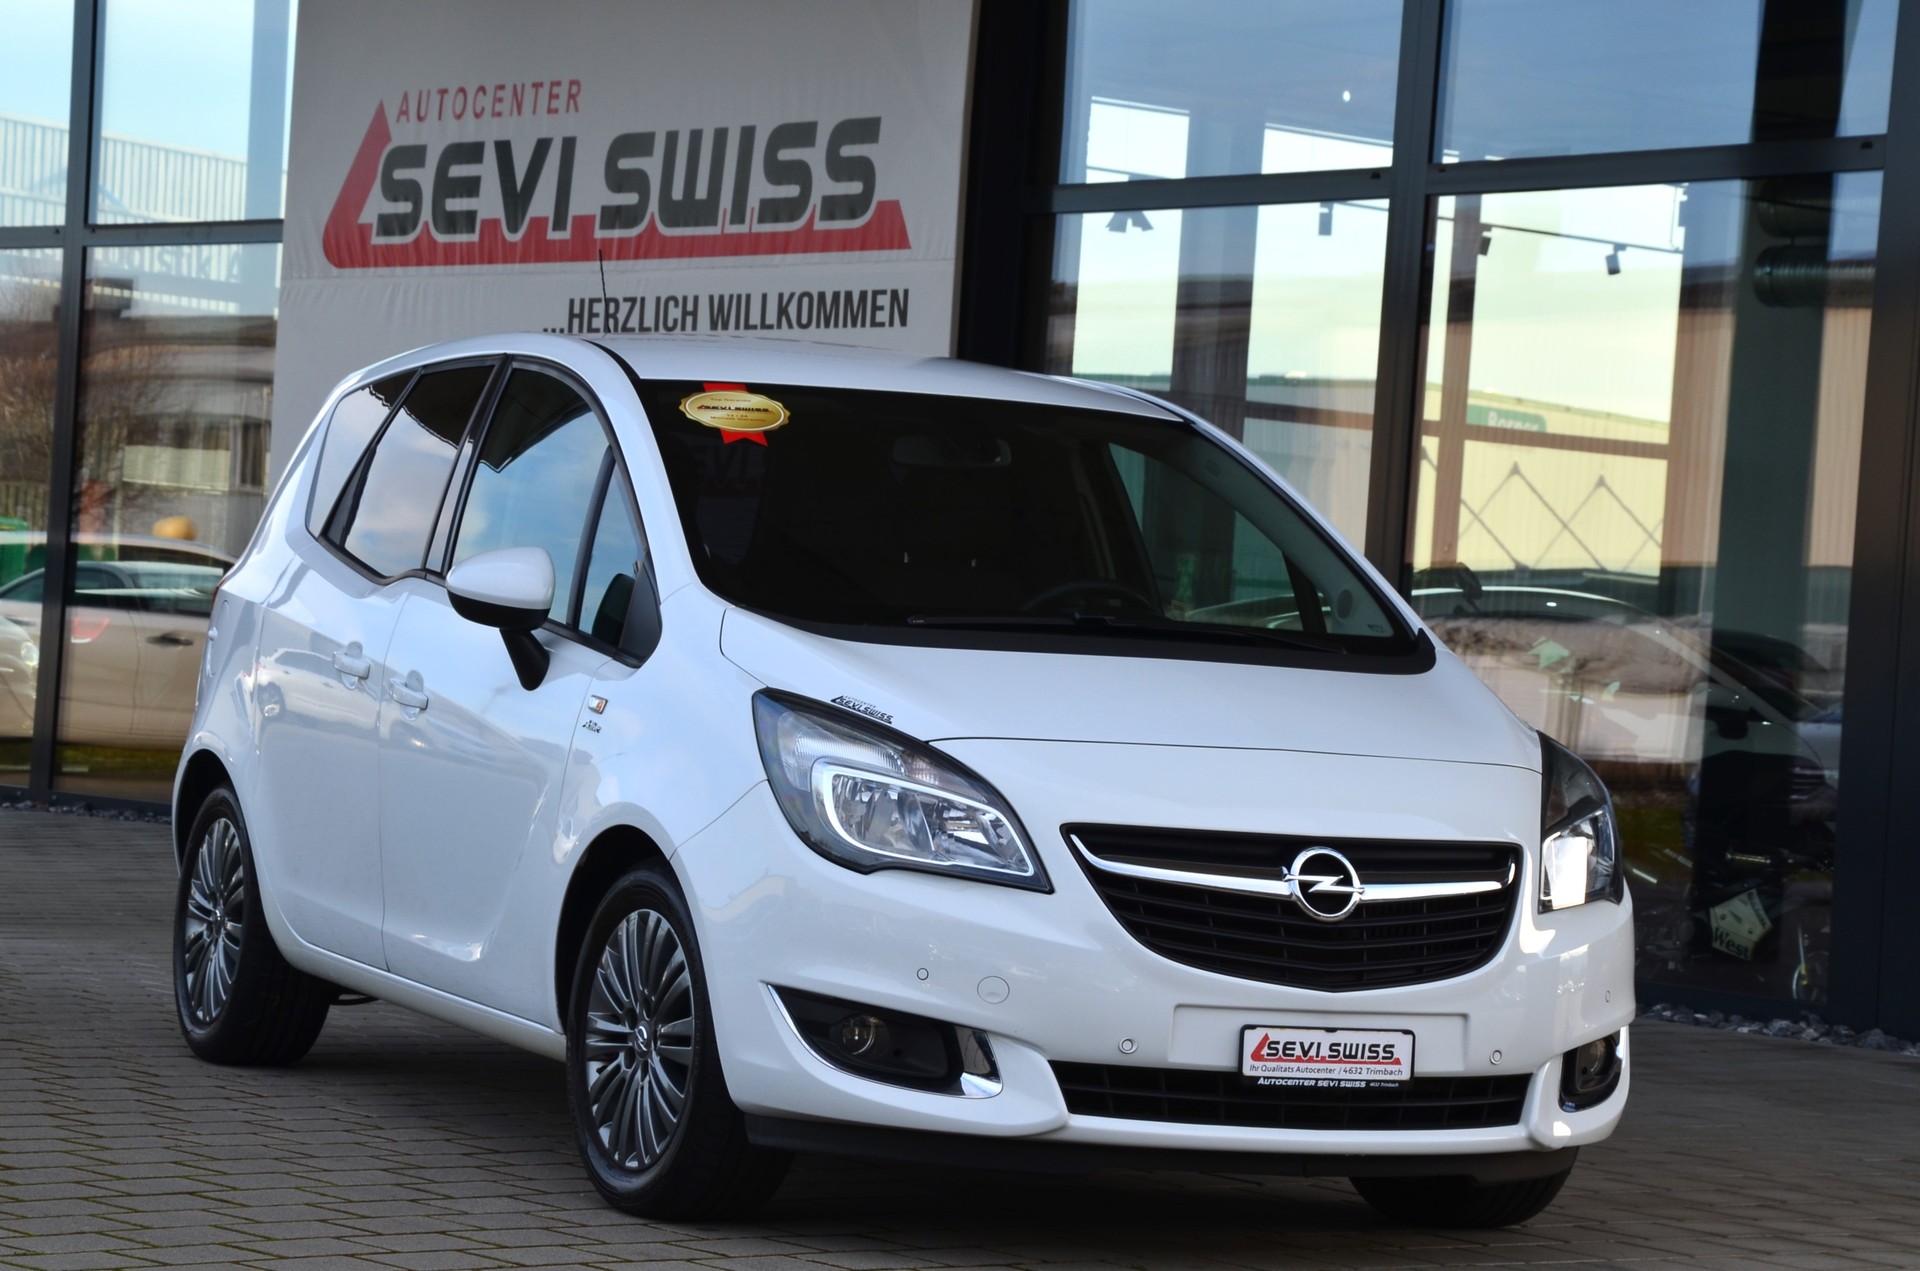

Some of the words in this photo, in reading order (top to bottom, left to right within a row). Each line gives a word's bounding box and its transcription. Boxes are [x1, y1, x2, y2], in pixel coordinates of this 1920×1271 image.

[396, 79, 582, 123] AUTOCENTER
[375, 136, 578, 238] SEVI
[598, 116, 882, 231] SWISS
[708, 288, 909, 331] WILLKOMMEN
[838, 697, 862, 711] SEVI
[862, 706, 893, 721] SWISS
[1714, 926, 1749, 959] West
[1266, 1040, 1322, 1059] SEVI
[1328, 1042, 1395, 1061] SWISS
[1249, 1064, 1259, 1072] Ihr
[1296, 1066, 1336, 1074] Autocenter
[1366, 1068, 1403, 1076] Trimbach
[1317, 1080, 1338, 1088] SEVI
